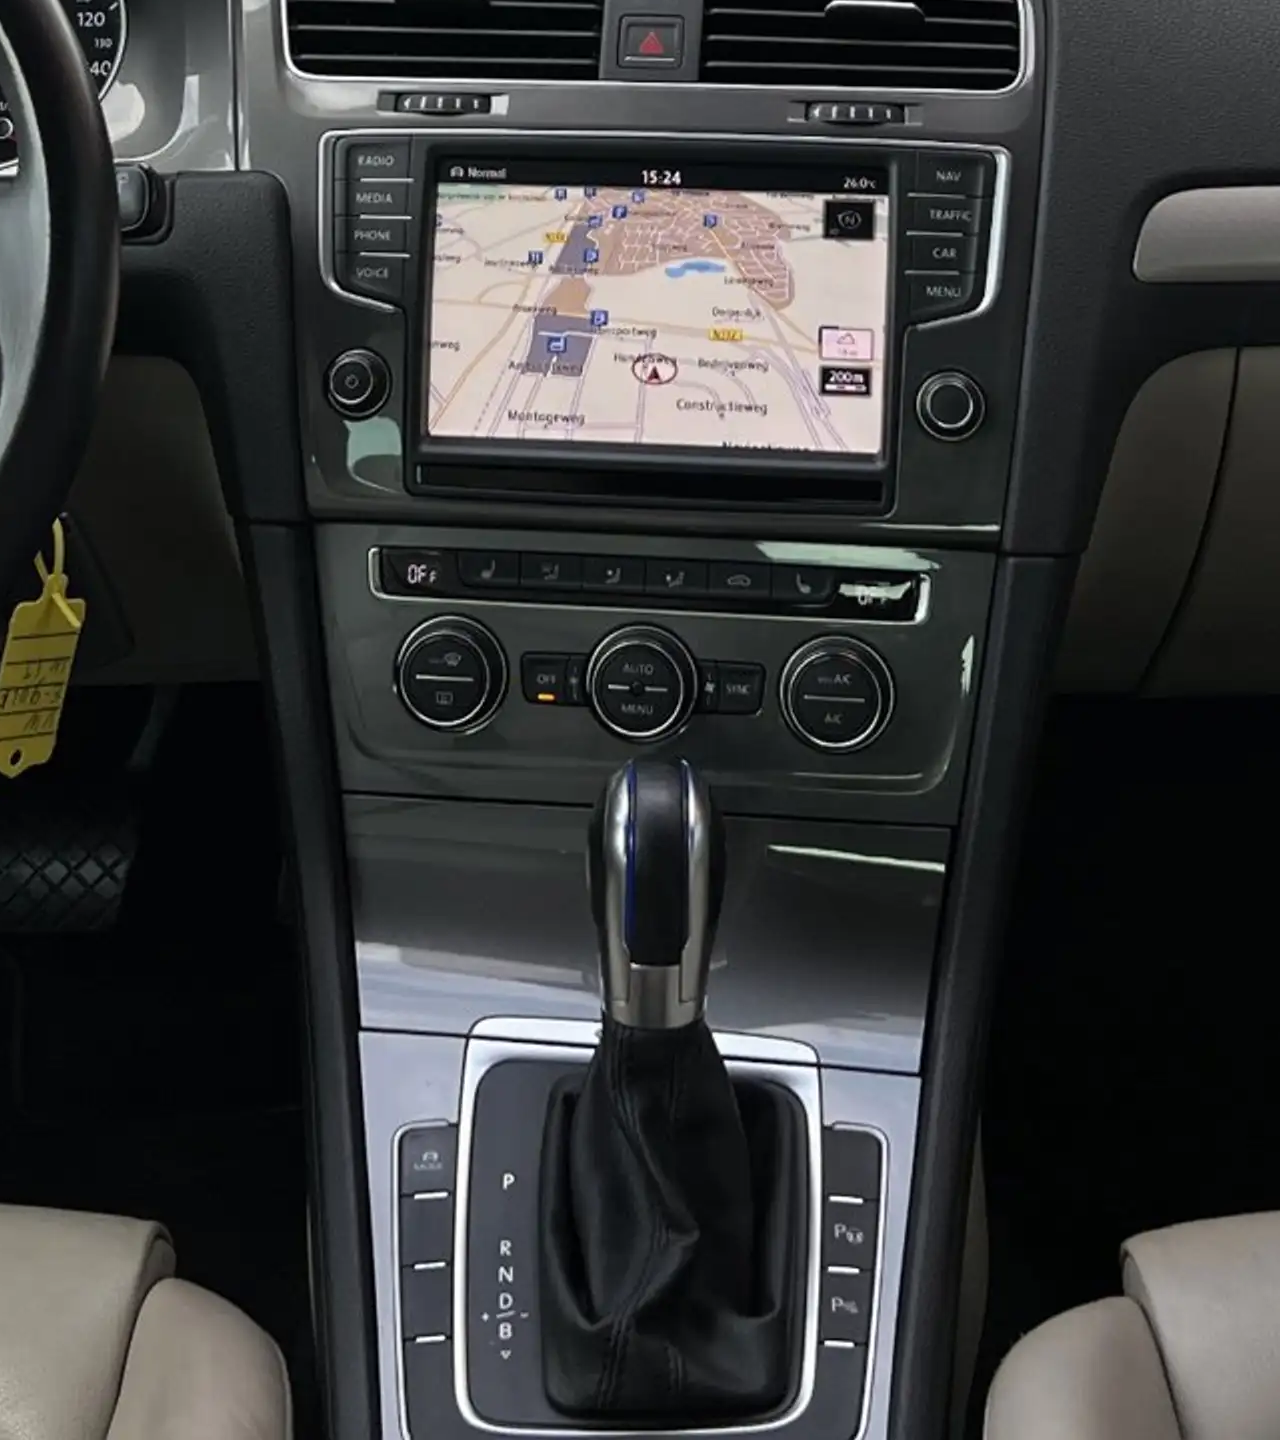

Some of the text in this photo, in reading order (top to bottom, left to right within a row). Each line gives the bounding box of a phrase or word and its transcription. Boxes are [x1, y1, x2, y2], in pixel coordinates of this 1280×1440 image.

[76, 11, 106, 28] 120
[357, 155, 395, 167] RADIO
[468, 167, 508, 179] Normal
[641, 170, 682, 186] 15:24
[936, 170, 962, 182] NAV
[355, 192, 393, 204] MEDIA
[929, 209, 973, 221] TRAFFIC
[354, 229, 391, 241] PHONE
[932, 247, 958, 259] CAR
[355, 267, 389, 279] VOICE
[925, 285, 962, 298] MENU
[406, 563, 438, 584] OFF
[622, 663, 655, 676] AUTO
[536, 674, 557, 685] OFF
[725, 683, 752, 695] SYNC
[621, 703, 654, 715] MENU
[502, 1172, 516, 1190] P
[499, 1239, 512, 1257] R
[497, 1265, 514, 1283] N
[498, 1292, 514, 1310] D
[498, 1322, 513, 1340] B
